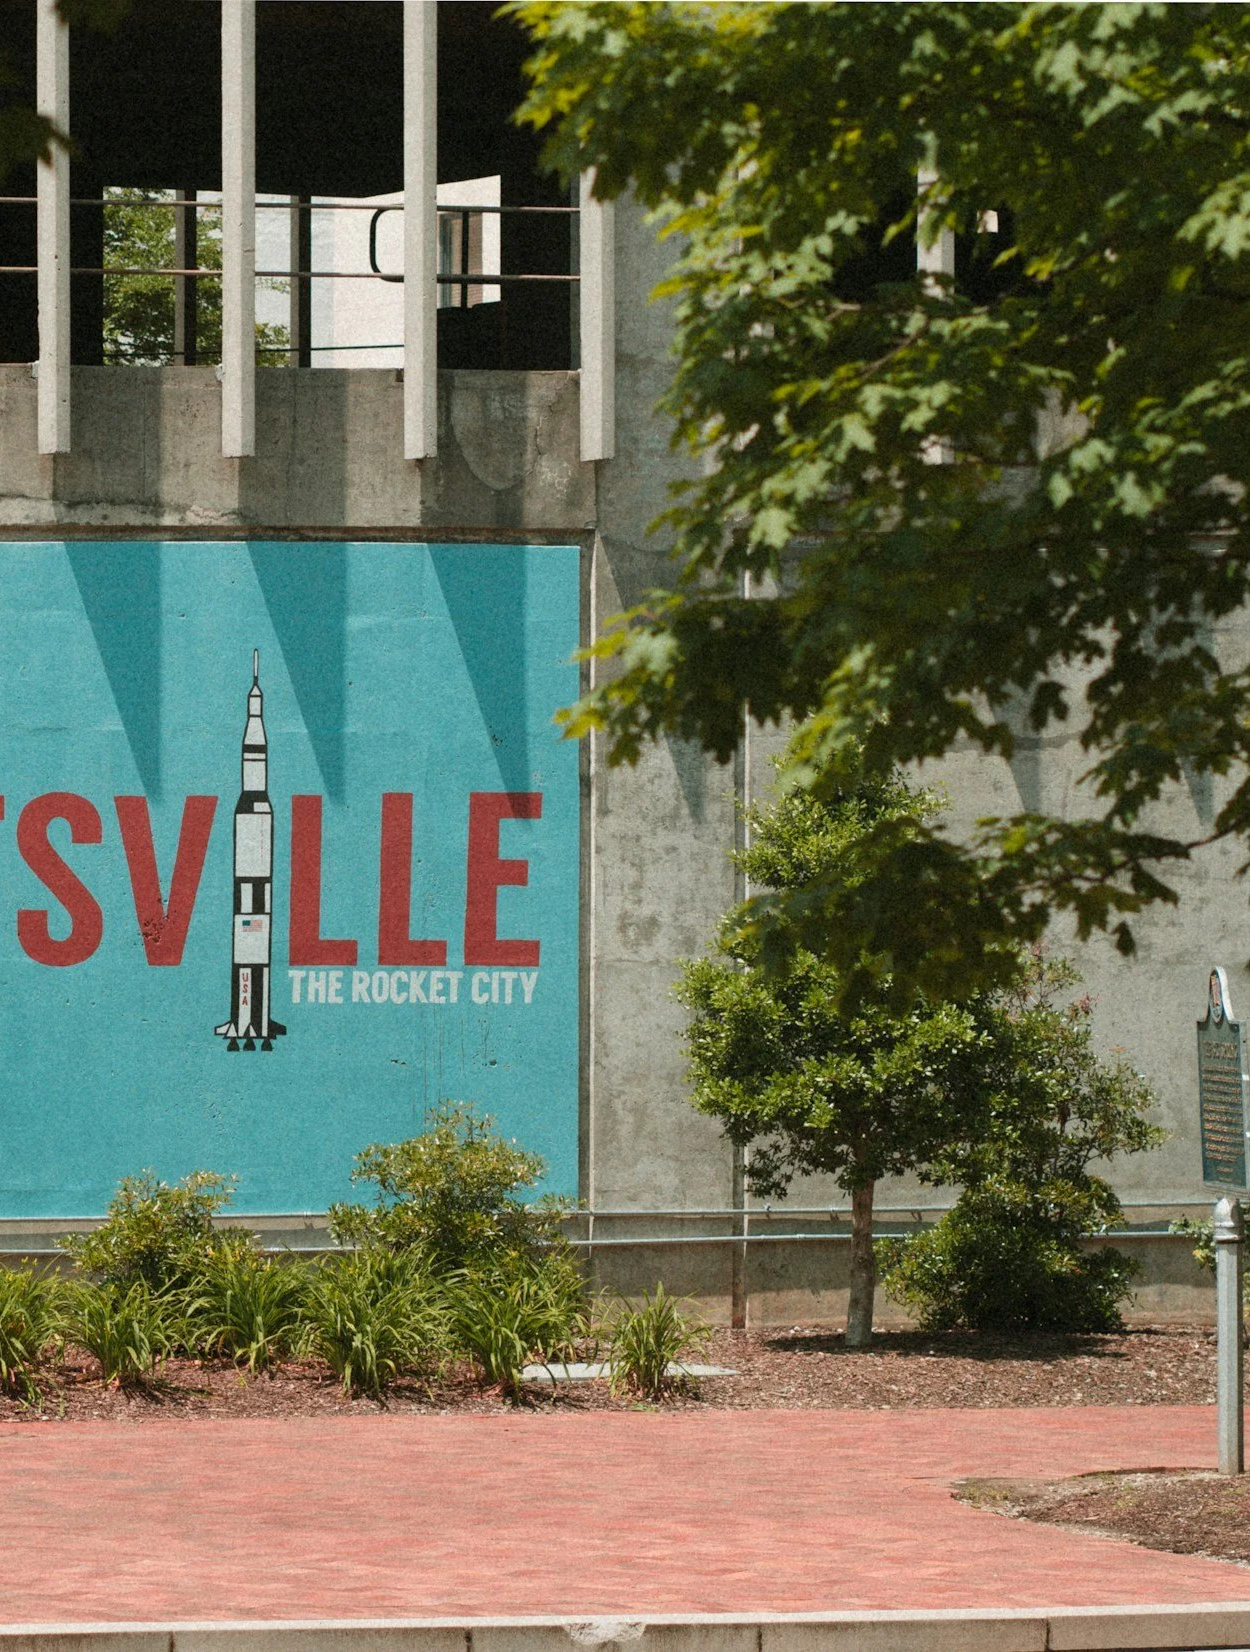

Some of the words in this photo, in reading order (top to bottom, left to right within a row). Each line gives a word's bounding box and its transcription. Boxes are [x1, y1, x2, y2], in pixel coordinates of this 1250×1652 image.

[288, 970, 344, 1004] THE
[352, 970, 463, 1004] ROCKET
[471, 971, 539, 1004] CITY
